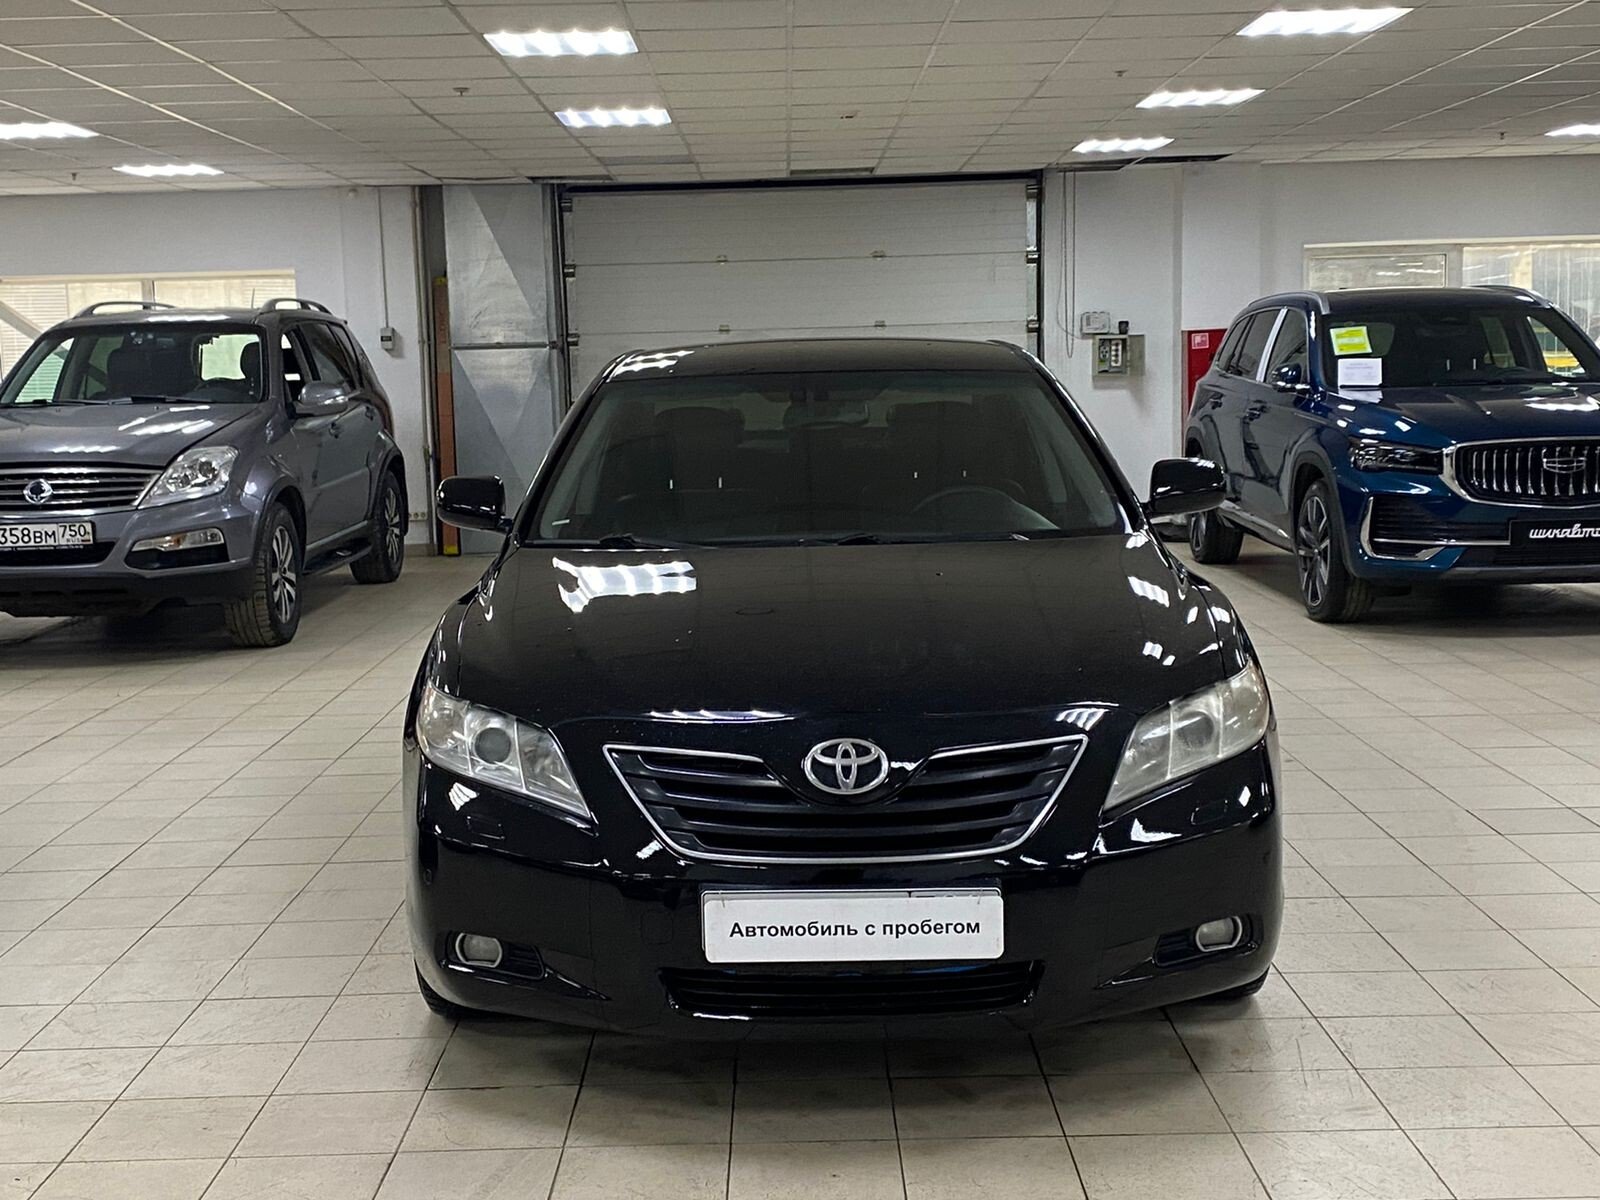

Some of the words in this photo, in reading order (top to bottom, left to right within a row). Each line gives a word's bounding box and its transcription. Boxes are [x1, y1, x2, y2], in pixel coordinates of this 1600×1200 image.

[59, 524, 87, 538] 750
[729, 921, 859, 938] Автомобиль
[865, 924, 876, 936] с
[883, 919, 980, 939] пробегом
